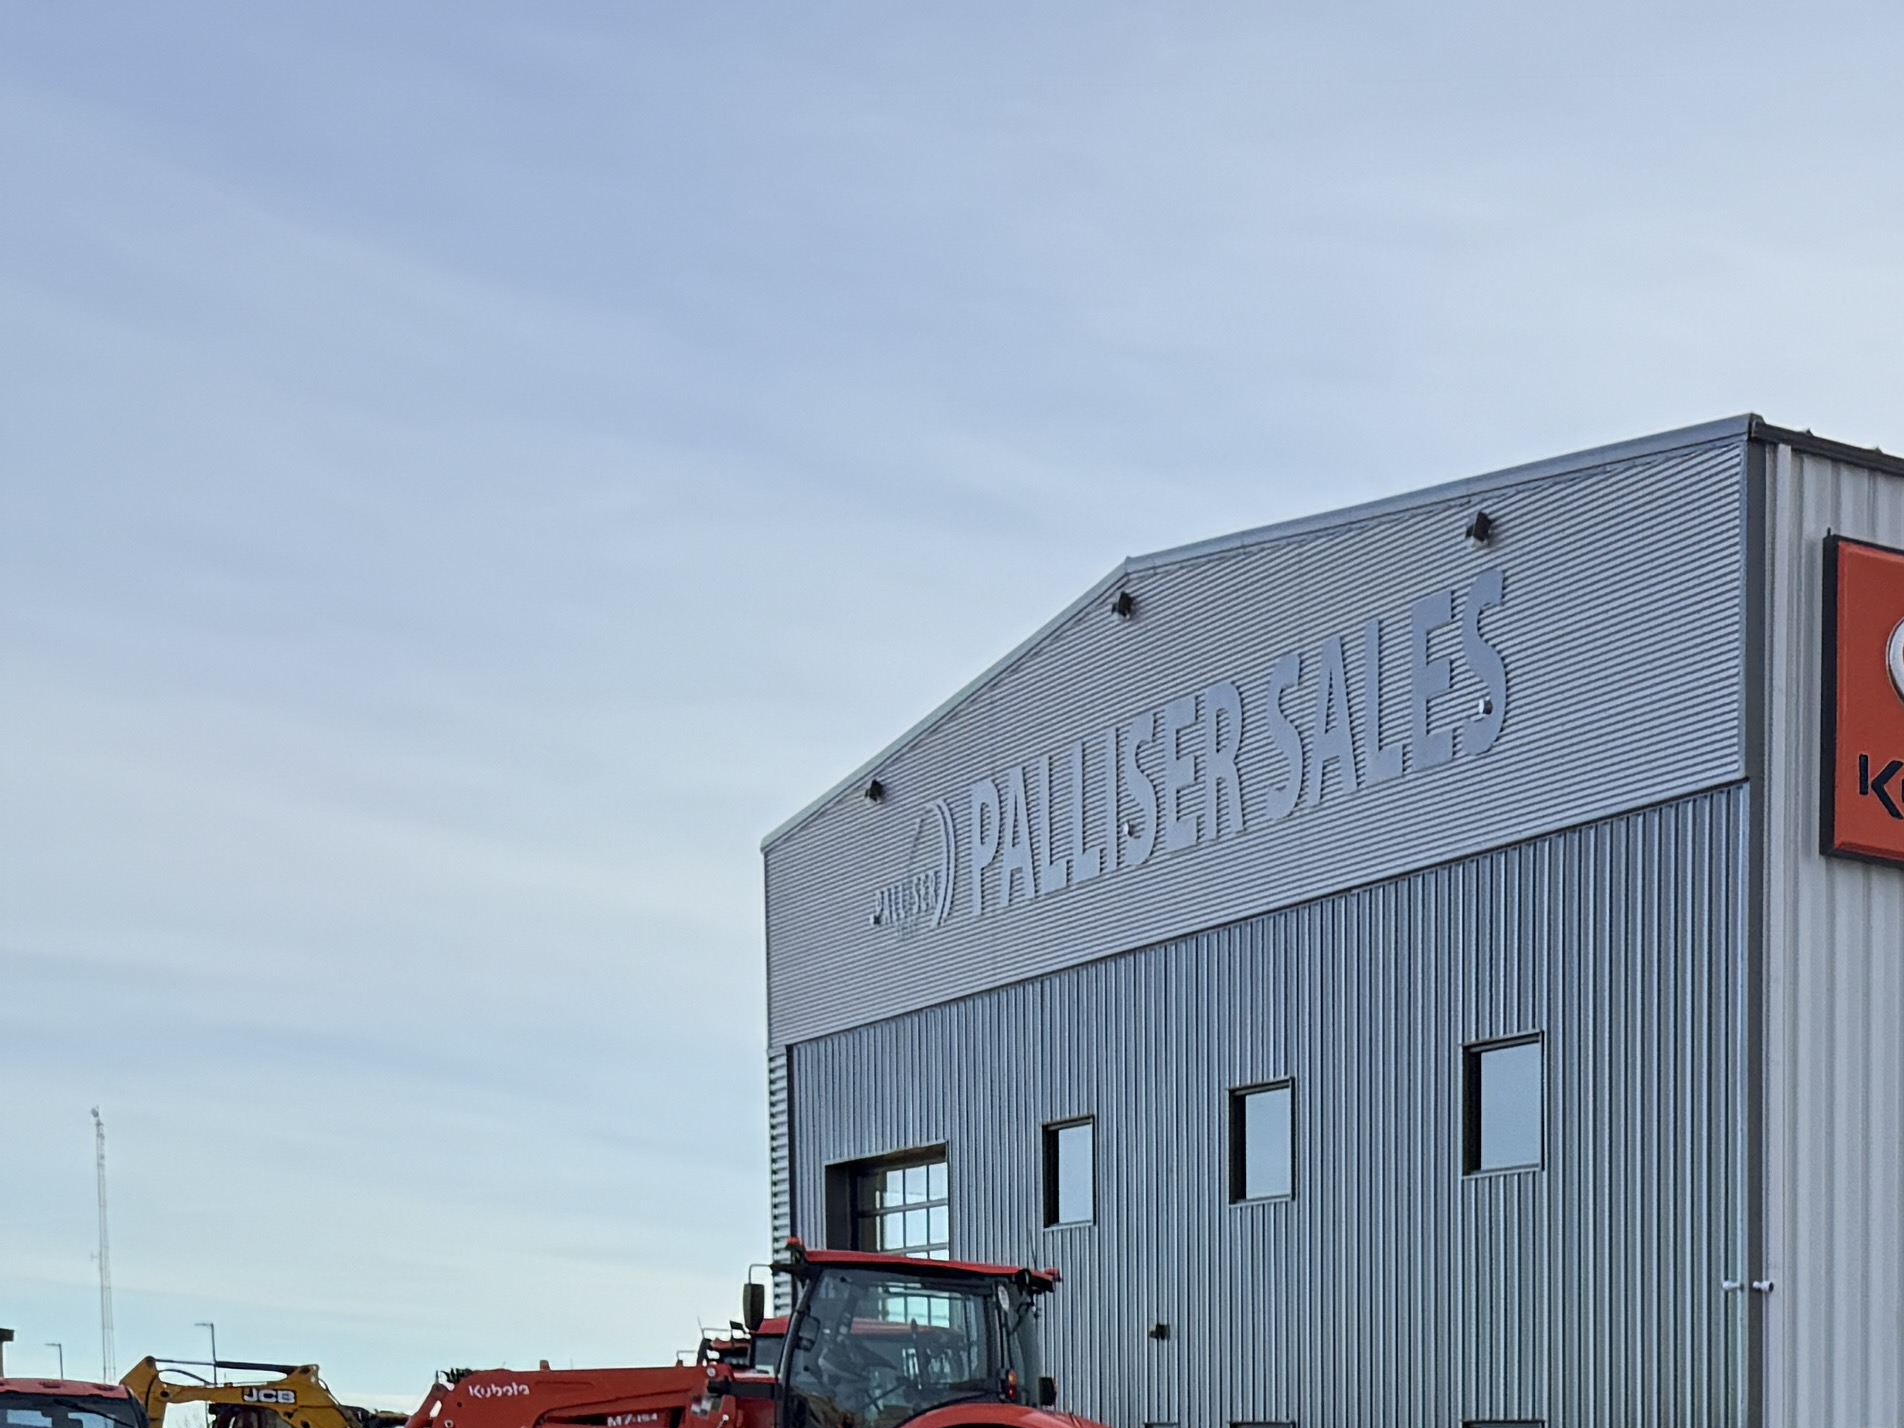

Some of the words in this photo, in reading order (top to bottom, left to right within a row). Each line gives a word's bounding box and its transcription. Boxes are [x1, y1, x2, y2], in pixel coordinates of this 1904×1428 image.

[970, 681, 1245, 916] PALLISER
[1264, 569, 1507, 822] SALES
[243, 1387, 296, 1404] JCB
[468, 1381, 531, 1399] Kubota
